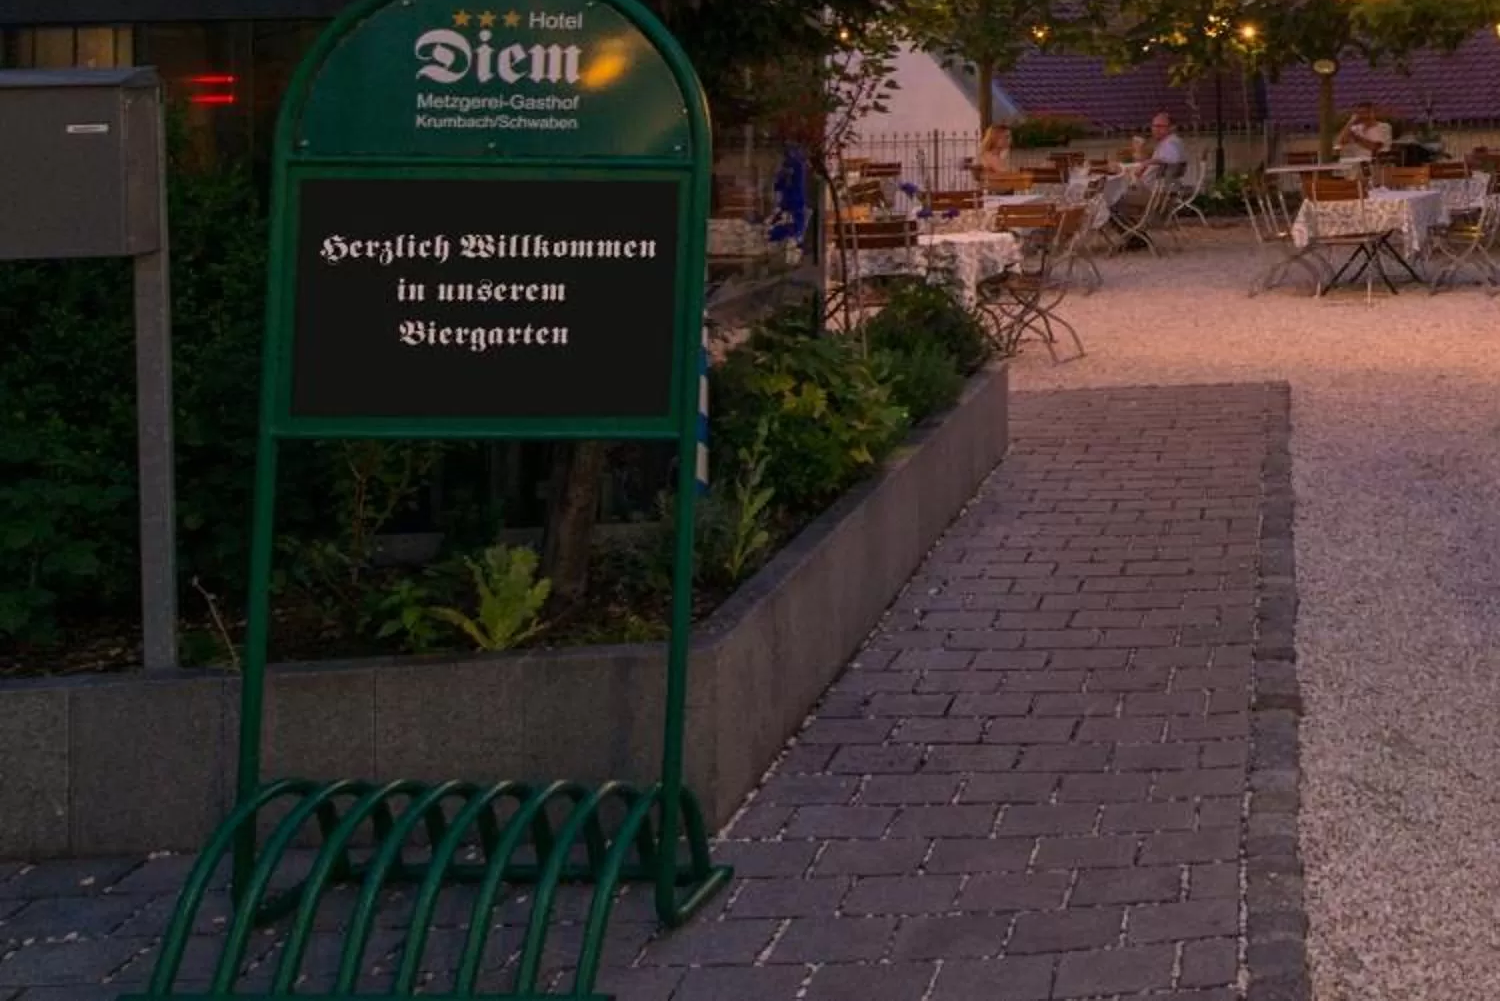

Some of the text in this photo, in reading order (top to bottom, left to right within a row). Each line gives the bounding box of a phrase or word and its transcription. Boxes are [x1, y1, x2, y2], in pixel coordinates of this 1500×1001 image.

[528, 12, 583, 32] Hotel
[415, 28, 582, 84] Diem
[416, 93, 580, 112] Metzgerei-Gasthof
[416, 114, 578, 130] Krumbach/Schwaben
[319, 234, 657, 265] Herzlich Willkommen
[396, 278, 566, 302] in unserem
[399, 320, 570, 352] Biergarten
